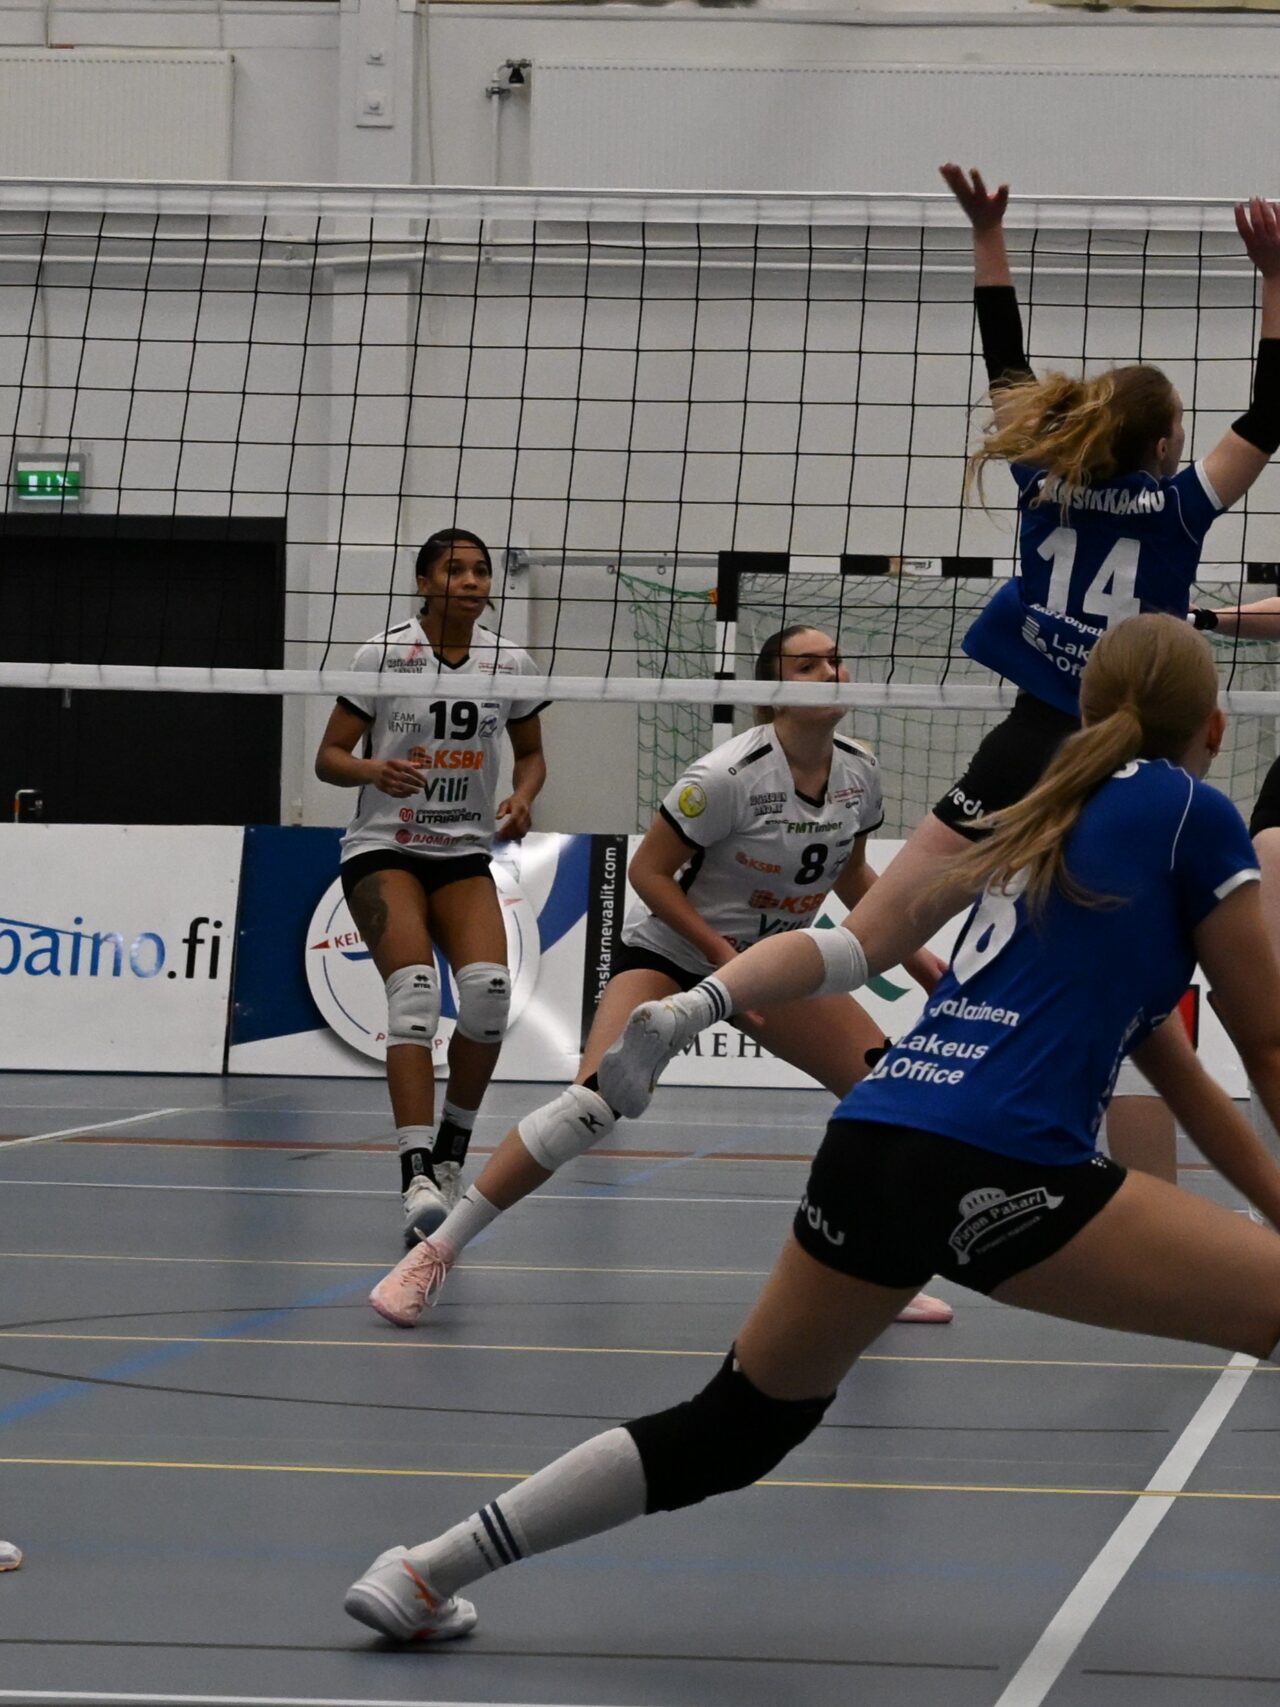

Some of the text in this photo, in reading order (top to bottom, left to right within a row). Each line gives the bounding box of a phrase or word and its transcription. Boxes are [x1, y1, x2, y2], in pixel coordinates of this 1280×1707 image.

[1037, 527, 1141, 626] 14
[1052, 633, 1090, 661] Lak
[429, 701, 479, 740] 19
[424, 776, 469, 802] Villi
[794, 843, 829, 885] 8
[897, 1033, 990, 1060] Lakeus
[890, 1057, 965, 1085] Office
